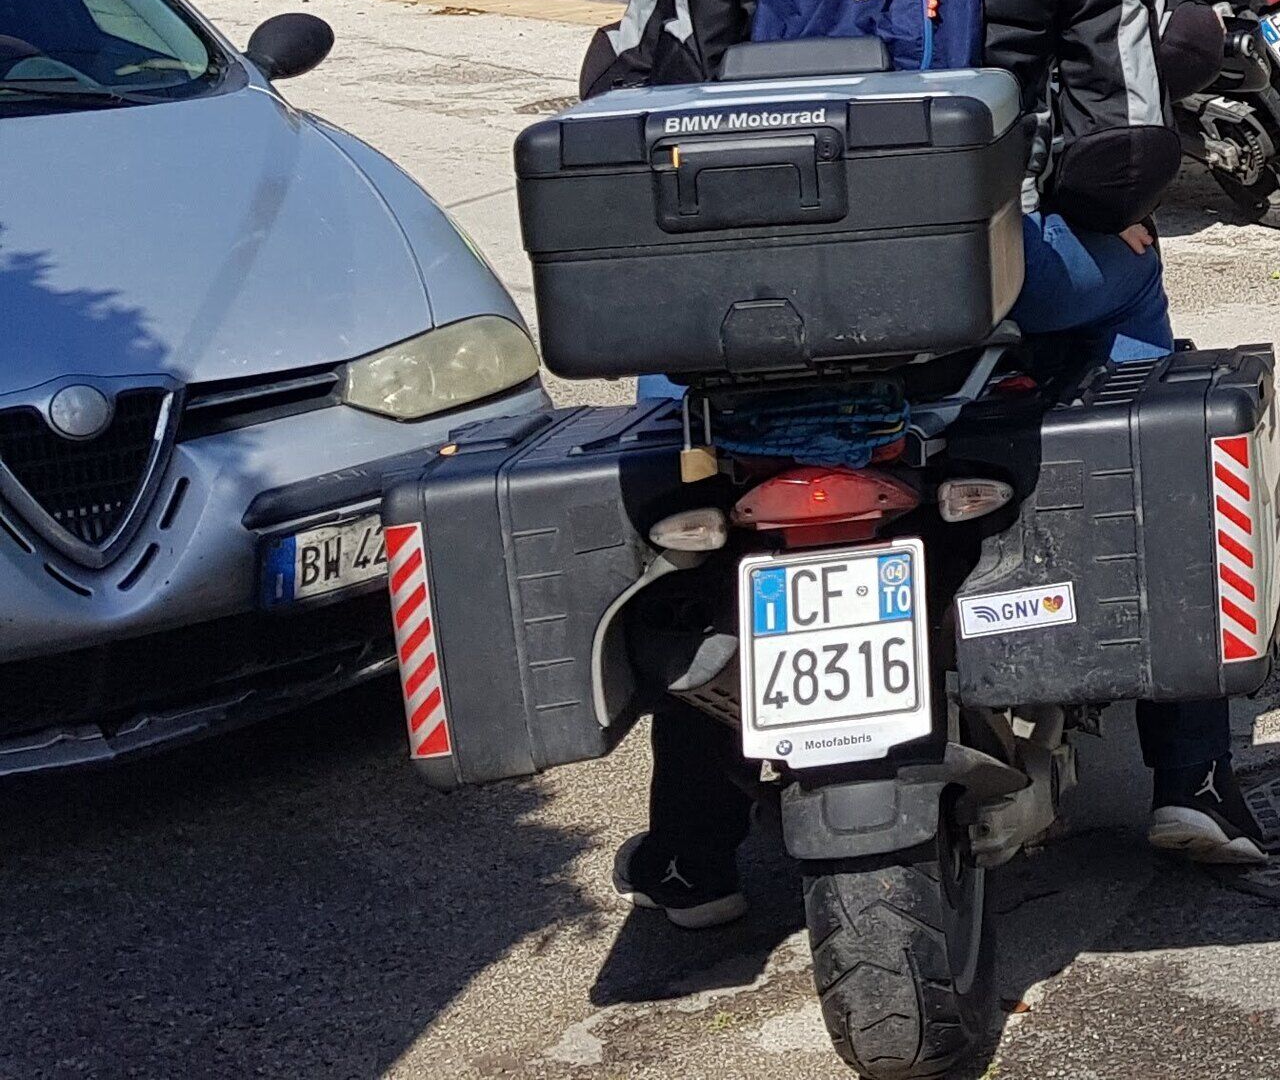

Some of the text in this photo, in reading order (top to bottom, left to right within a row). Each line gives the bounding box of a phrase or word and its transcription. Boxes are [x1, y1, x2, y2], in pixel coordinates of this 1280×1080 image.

[665, 108, 826, 133] BMW Motorrad
[300, 536, 342, 587] BW
[886, 565, 903, 580] 04
[791, 564, 848, 626] CF
[883, 585, 911, 613] TO
[1001, 598, 1040, 620] GNV
[762, 637, 910, 710] 48316
[805, 733, 872, 750] Motofabbris
